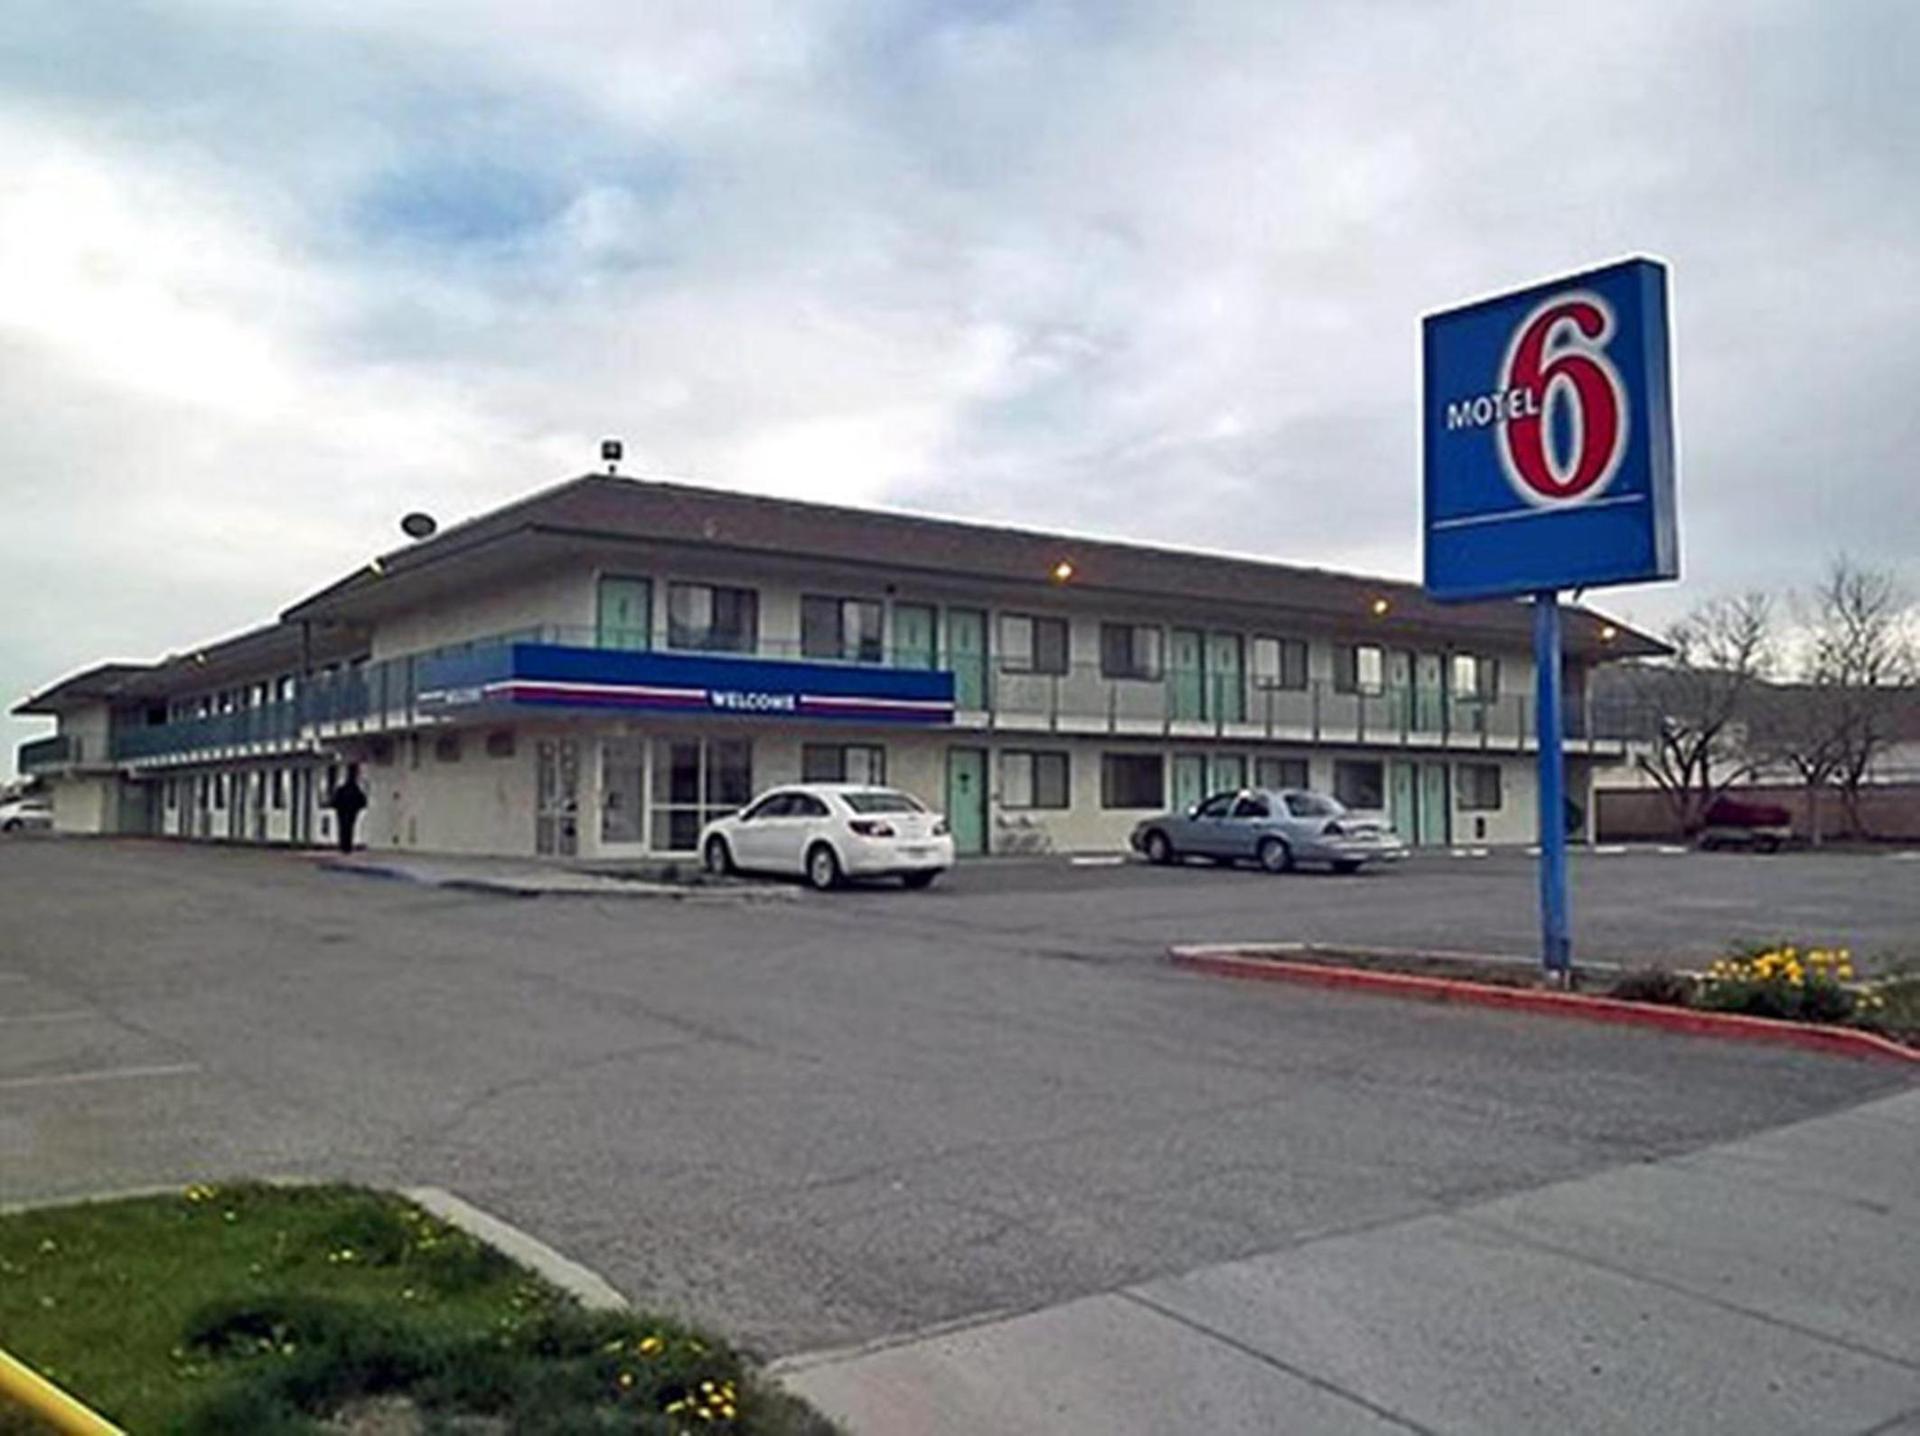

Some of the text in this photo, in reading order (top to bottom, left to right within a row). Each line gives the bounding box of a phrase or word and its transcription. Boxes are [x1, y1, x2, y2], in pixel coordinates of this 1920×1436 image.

[1447, 294, 1627, 505] MOTEL 6
[712, 691, 796, 711] WELCOME
